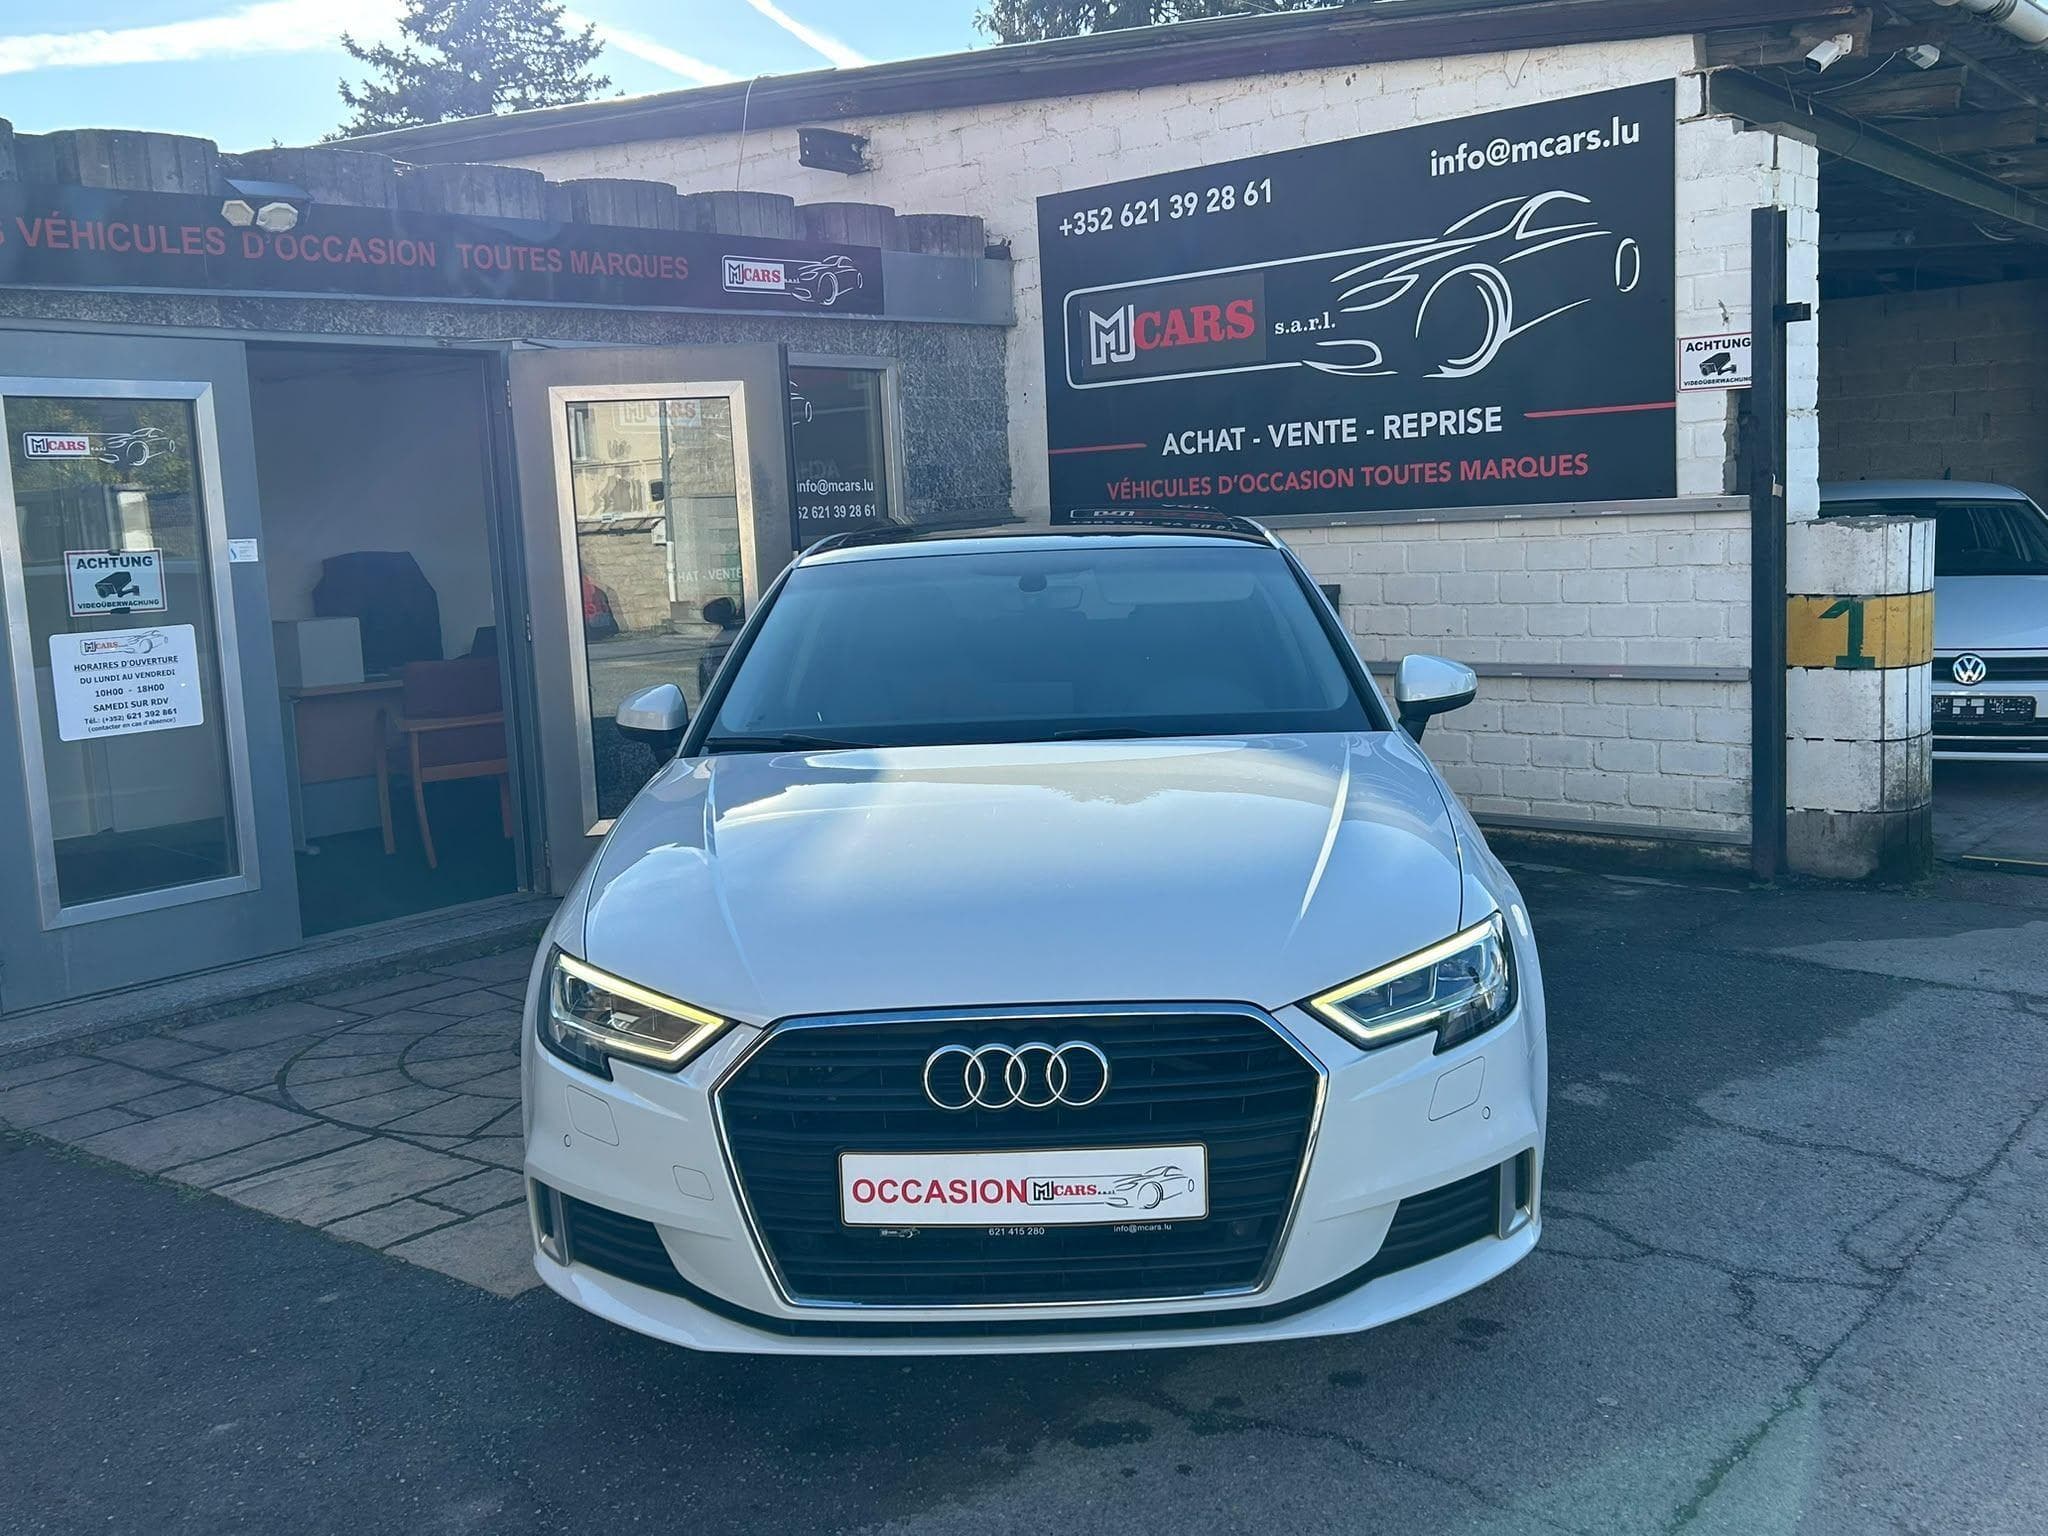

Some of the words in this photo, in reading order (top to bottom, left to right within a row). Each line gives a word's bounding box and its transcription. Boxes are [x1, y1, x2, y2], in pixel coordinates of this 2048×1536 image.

[1430, 116, 1640, 177] info@mcars.lu
[1059, 206, 1113, 236] +352
[1119, 198, 1160, 228] 621
[1169, 191, 1199, 220] 39
[1206, 185, 1236, 213] 28
[1243, 178, 1272, 206] 61
[16, 211, 226, 256] VÉHICULES
[456, 243, 562, 273] TOUTES
[570, 249, 689, 280] MARQUES
[1274, 311, 1336, 335] s.a.r.l.
[1685, 337, 1752, 352] ACHTUNG
[1161, 426, 1246, 456] ACHAT
[1267, 418, 1357, 448] VENTE
[1383, 406, 1503, 440] REPRISE
[1107, 477, 1212, 500] VÉHICULES
[1218, 468, 1354, 495] D'OCCASION
[1361, 461, 1452, 487] TOUTES
[1459, 452, 1589, 482] MARQUES
[811, 505, 830, 519] 621
[833, 504, 847, 518] 39
[849, 504, 862, 518] 28
[864, 503, 876, 517] 61
[76, 557, 153, 569] ACHTUNG
[77, 599, 160, 610] VIDEOÜBERWACHUNG
[1817, 599, 1876, 671] 1
[74, 661, 119, 672] HORAIRES
[121, 655, 179, 667] D'OUVERTURE
[80, 676, 92, 685] DU
[94, 674, 121, 683] LUNDI
[122, 672, 133, 681] AU
[135, 668, 175, 679] VENDREDI
[95, 687, 124, 698] 10H00
[137, 683, 165, 694] 18H00
[93, 701, 129, 712] SAMEDI
[130, 699, 149, 709] SUR
[151, 697, 169, 706] RDV
[126, 711, 142, 720] 621
[851, 1178, 1027, 1206] OCCASION
[988, 1227, 1005, 1236] 621
[1007, 1227, 1025, 1236] 415
[1027, 1226, 1045, 1236] 280
[1113, 1222, 1172, 1234] info@mcars.lu
